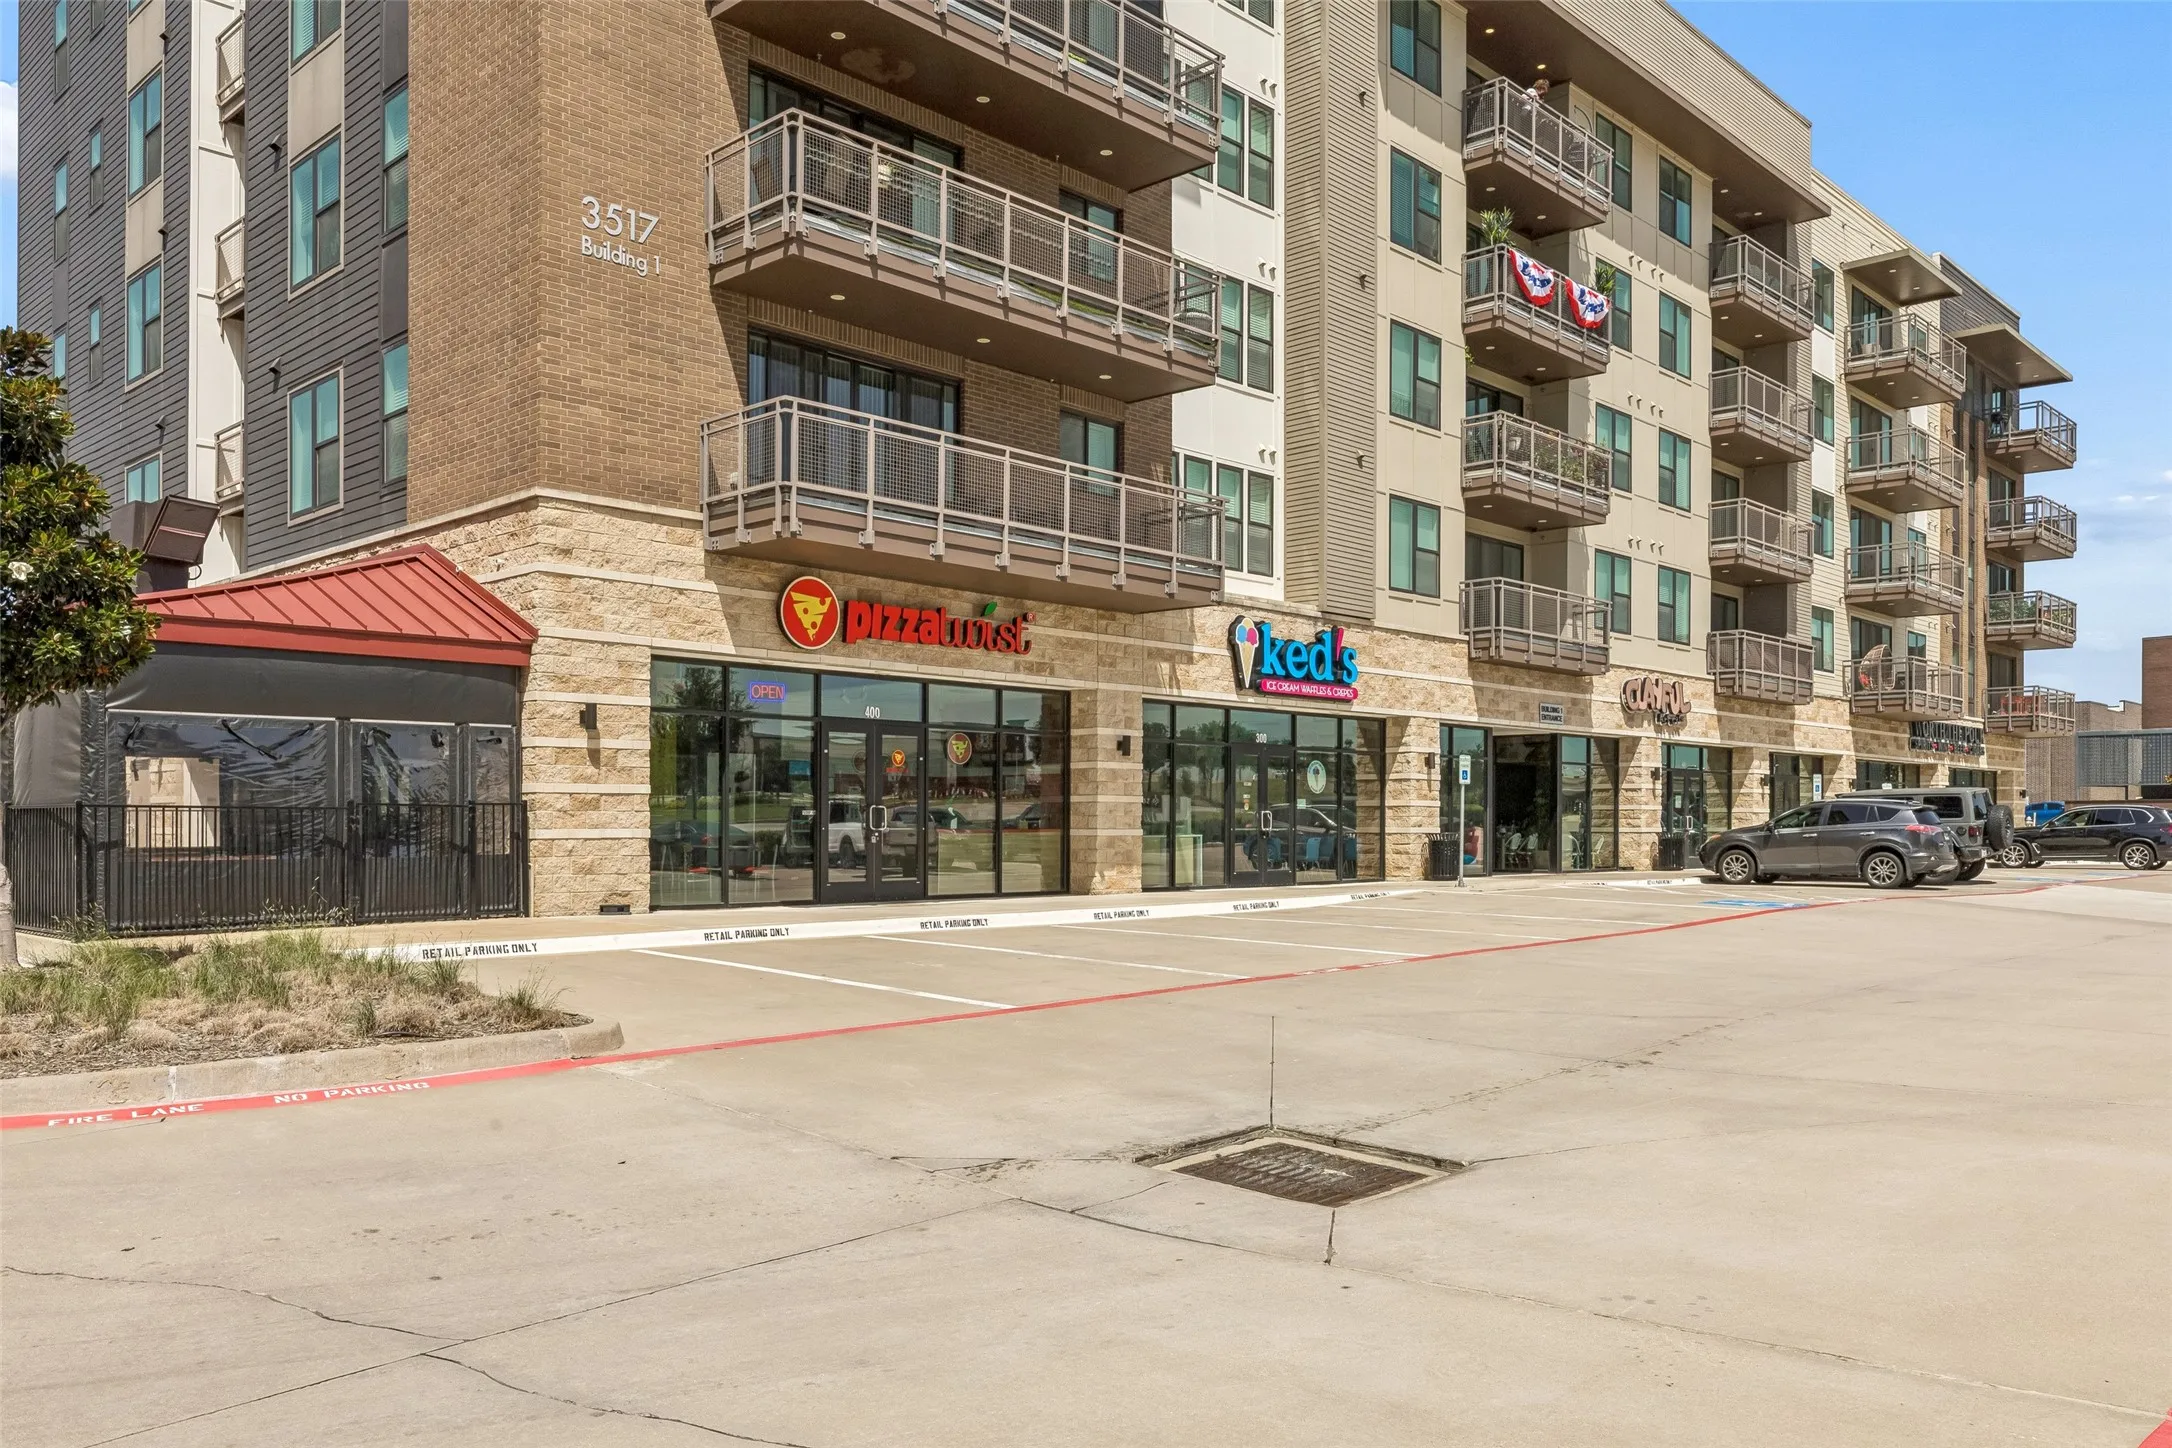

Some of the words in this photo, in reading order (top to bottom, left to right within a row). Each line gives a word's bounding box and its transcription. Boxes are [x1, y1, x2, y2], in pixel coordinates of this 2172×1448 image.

[581, 195, 660, 244] 3517
[581, 234, 648, 277] Building
[653, 255, 661, 276] 1
[1261, 622, 1359, 684] ked's
[751, 684, 785, 699] OPEN
[1266, 681, 1277, 691] ICE
[1277, 682, 1300, 693] CREAM
[1301, 684, 1326, 695] WAFFLES
[1326, 687, 1332, 696] &
[1332, 688, 1354, 698] CREPES
[864, 706, 881, 719] 400
[1541, 705, 1560, 714] BUILDING
[1541, 714, 1563, 722] ENTRANCE
[1255, 733, 1268, 743] 300
[1093, 911, 1113, 920] RETAIL
[1114, 910, 1135, 919] PARKING
[1136, 909, 1150, 917] ONLY
[920, 920, 943, 930] RETAIL
[944, 919, 971, 928] PARKING
[972, 918, 988, 926] ONLY
[704, 930, 733, 941] RETAIL
[735, 928, 768, 939] PARKING
[769, 927, 789, 937] ONLY
[422, 947, 462, 959] RETAIL
[464, 944, 509, 956] PARKING
[511, 943, 538, 953] ONLY
[48, 1113, 113, 1127] FIRE
[131, 1103, 205, 1119] LANE
[273, 1093, 308, 1104] NO
[323, 1082, 430, 1099] PARKING
